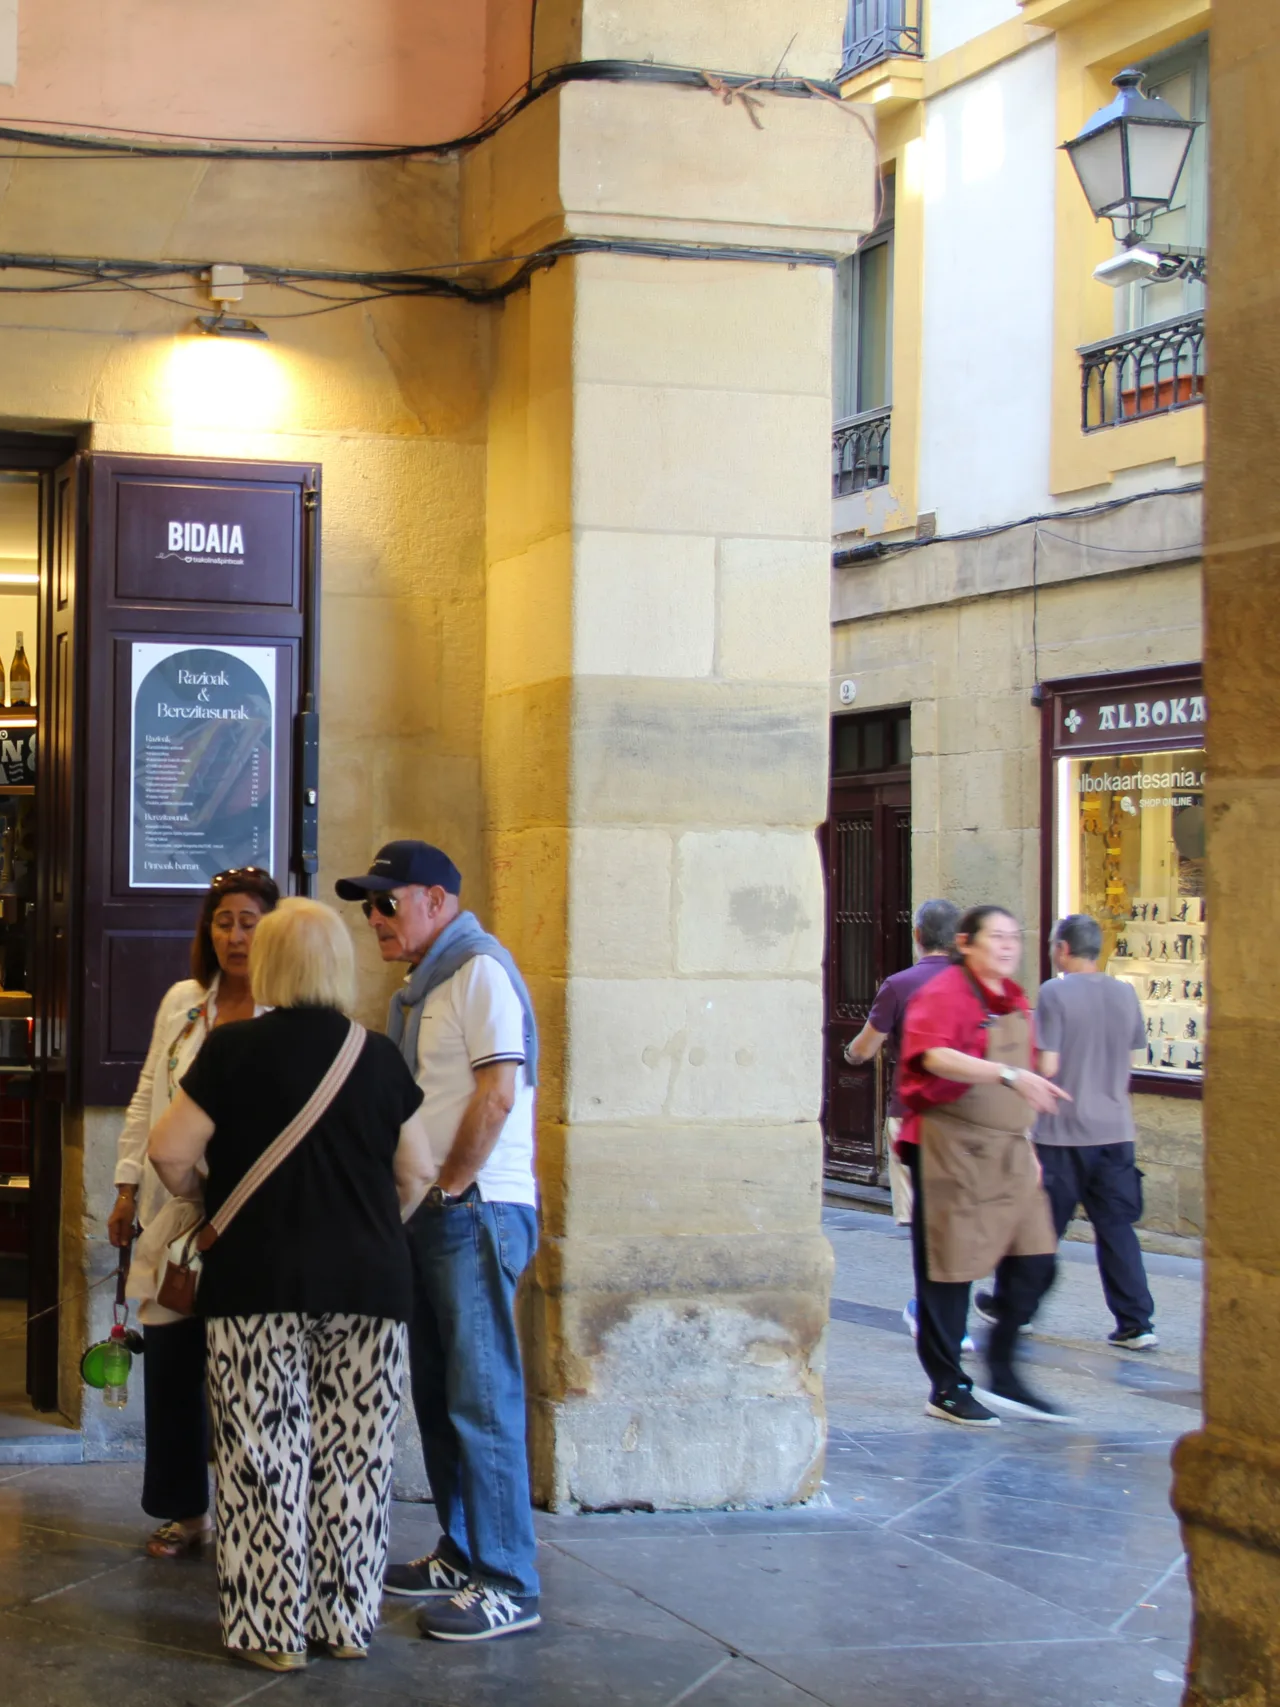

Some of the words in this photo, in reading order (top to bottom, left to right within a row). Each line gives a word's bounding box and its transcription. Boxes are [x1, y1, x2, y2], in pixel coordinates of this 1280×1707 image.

[167, 521, 245, 554] BIDAIA
[178, 669, 230, 686] Razioak
[197, 687, 210, 702] &
[842, 684, 850, 700] 2
[157, 702, 250, 720] Berezitasunak
[1098, 696, 1206, 730] ALBOKA
[1138, 797, 1161, 808] SHOP
[1162, 796, 1193, 807] ONLINE
